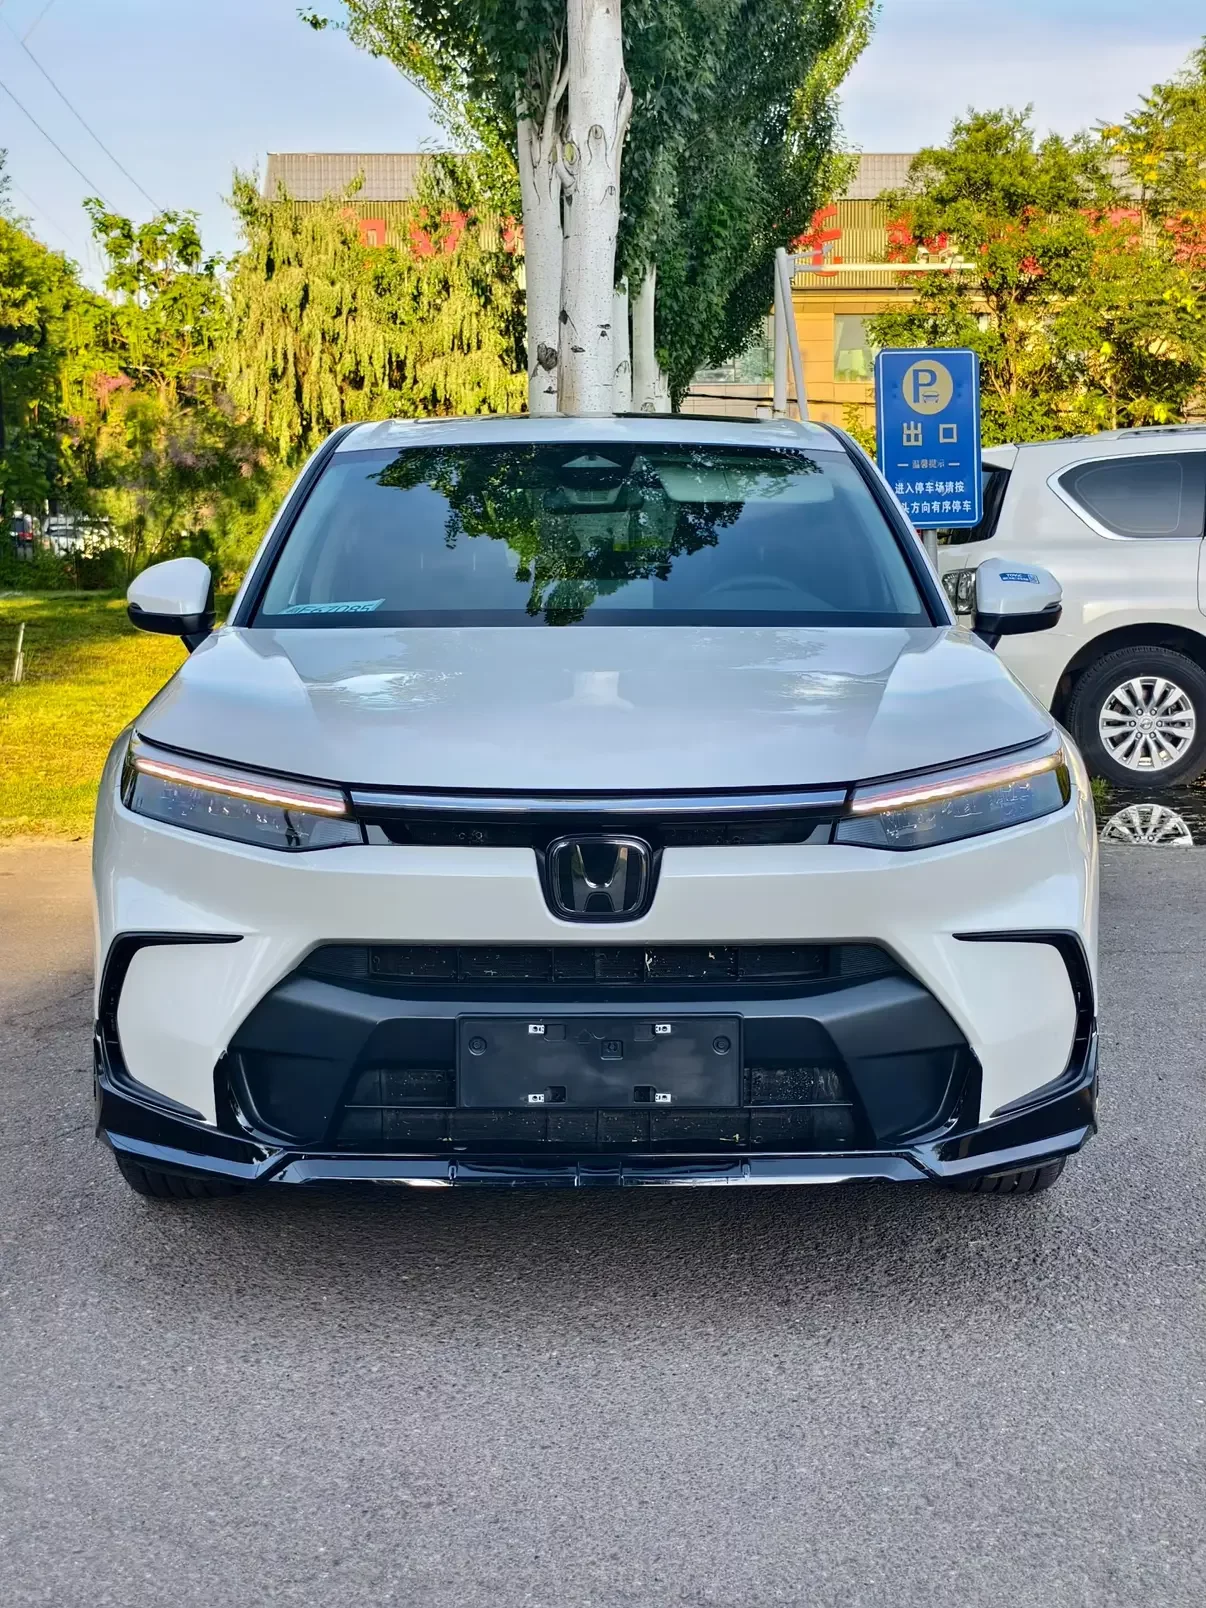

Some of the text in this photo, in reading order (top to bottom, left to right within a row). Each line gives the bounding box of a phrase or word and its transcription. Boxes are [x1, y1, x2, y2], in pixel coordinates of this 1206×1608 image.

[912, 368, 938, 404] P
[902, 420, 958, 447] 出口
[894, 480, 966, 495] 进入停车场请按
